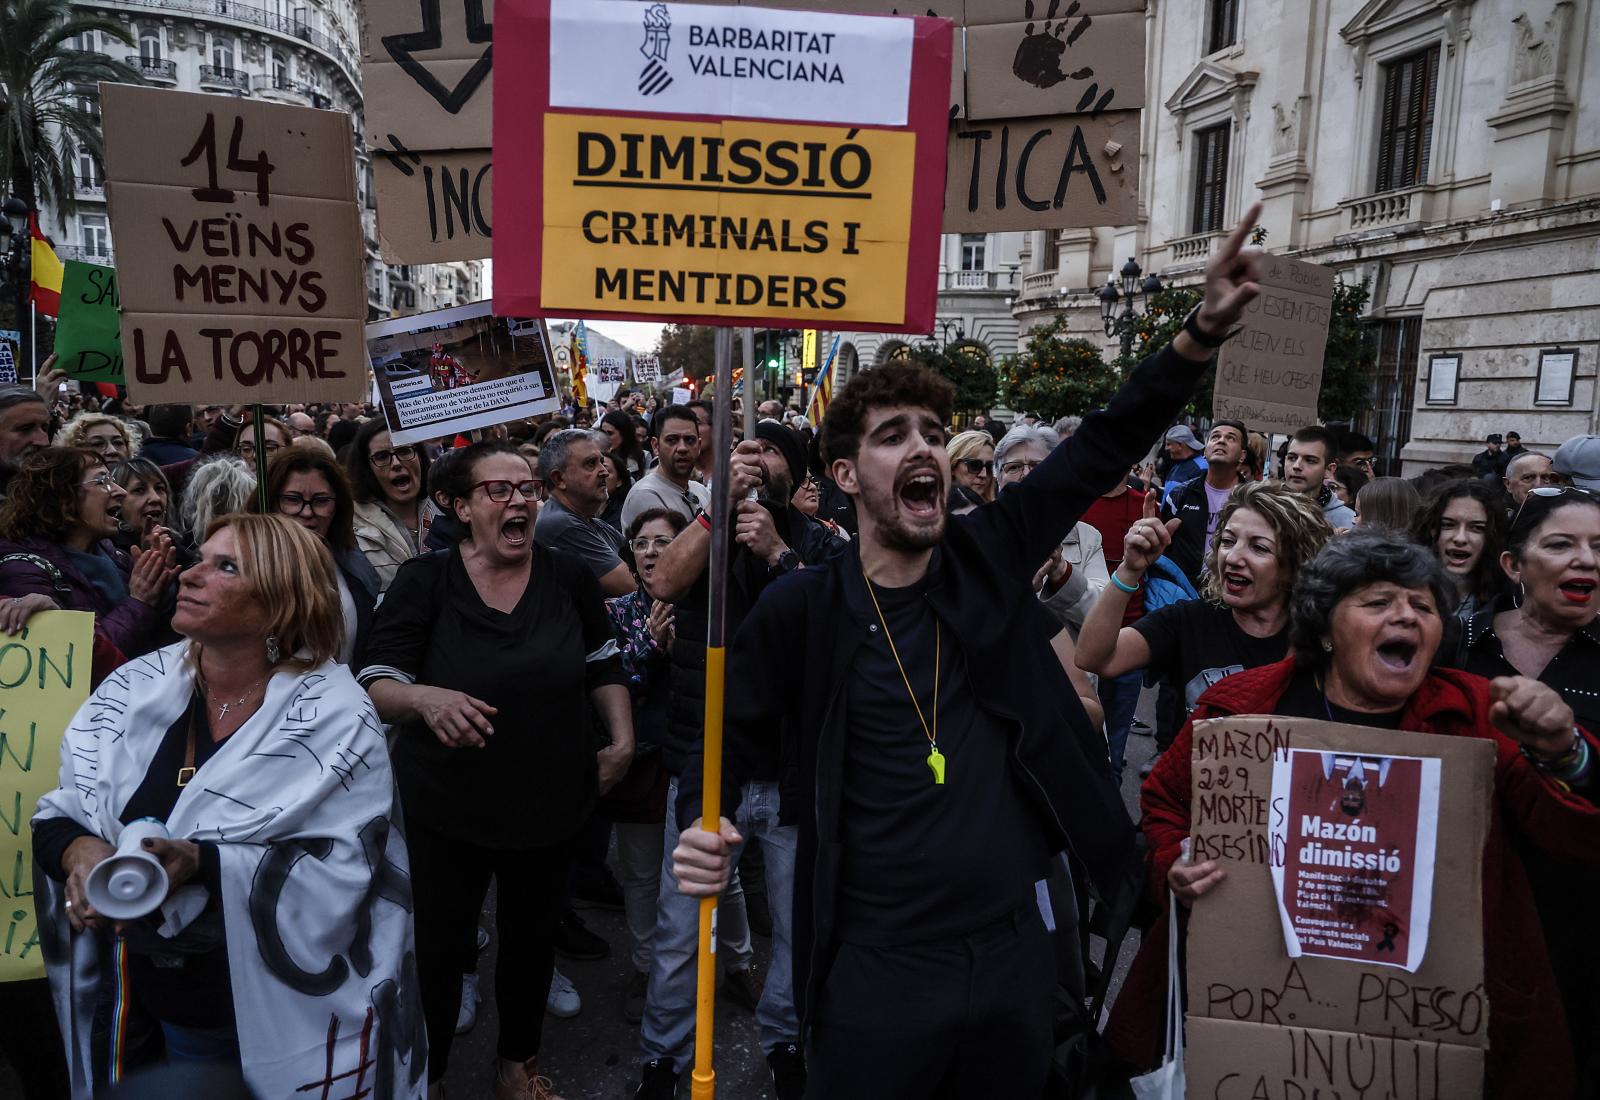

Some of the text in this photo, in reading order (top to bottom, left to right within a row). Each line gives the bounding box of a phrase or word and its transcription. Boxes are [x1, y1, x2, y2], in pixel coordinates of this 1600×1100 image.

[689, 25, 836, 54] BARBARITAT
[688, 54, 844, 84] VALENCIANA
[181, 113, 275, 206] 14
[577, 128, 872, 189] DIMISSIÓ
[944, 125, 1107, 213] TICA
[162, 212, 315, 265] VEÏNS
[582, 210, 860, 255] CRIMINALS I
[81, 269, 120, 308] SA
[173, 264, 327, 313] MENYS
[595, 267, 847, 310] MENTIDERS
[133, 328, 346, 387] LA TORRE
[401, 402, 447, 417] Ayuntamiento
[496, 384, 523, 396] requirió
[402, 411, 444, 425] especialistas
[451, 405, 472, 414] noche
[473, 402, 482, 410] de
[482, 400, 490, 408] la
[490, 396, 510, 406] DANA
[422, 395, 435, 404] 150
[435, 389, 468, 401] bomberos
[469, 381, 504, 394] denuncian
[505, 379, 518, 388] que
[1199, 720, 1291, 763] MAZÓN
[1198, 765, 1250, 792] 229
[1198, 790, 1284, 828] MORTES
[1301, 814, 1377, 843] Mazón
[1299, 842, 1401, 873] dimissió
[1298, 880, 1303, 888] 9
[1304, 881, 1315, 889] de
[1341, 932, 1370, 942] socials
